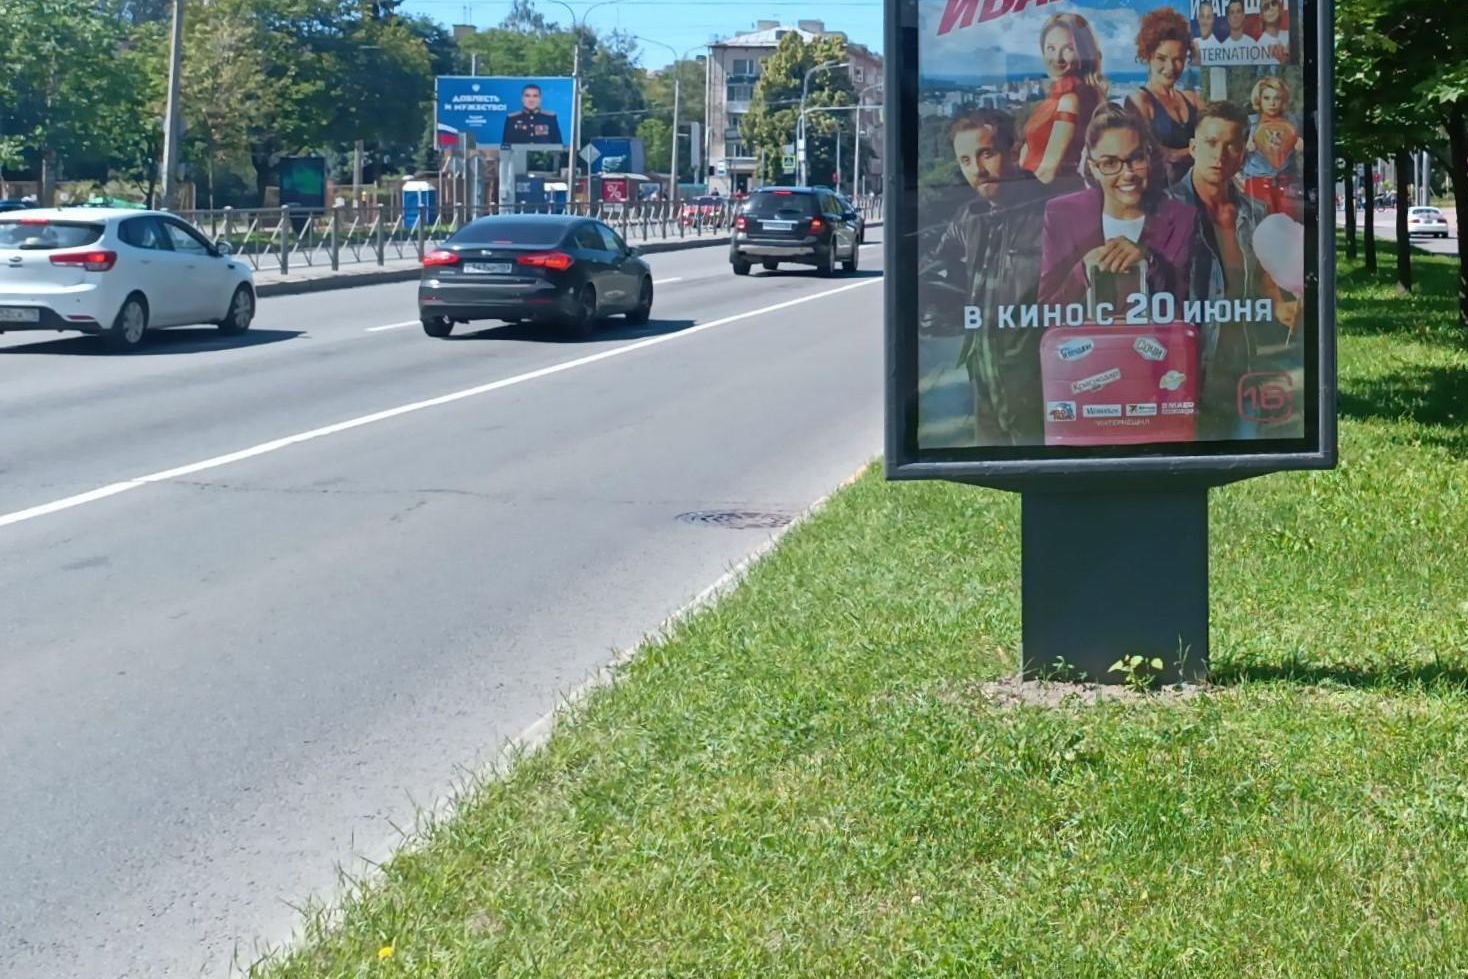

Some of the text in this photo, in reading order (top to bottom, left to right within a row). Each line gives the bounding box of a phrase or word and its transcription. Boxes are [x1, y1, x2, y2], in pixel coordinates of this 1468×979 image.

[963, 291, 1273, 330] В КИНО С 20 ИЮНЯ
